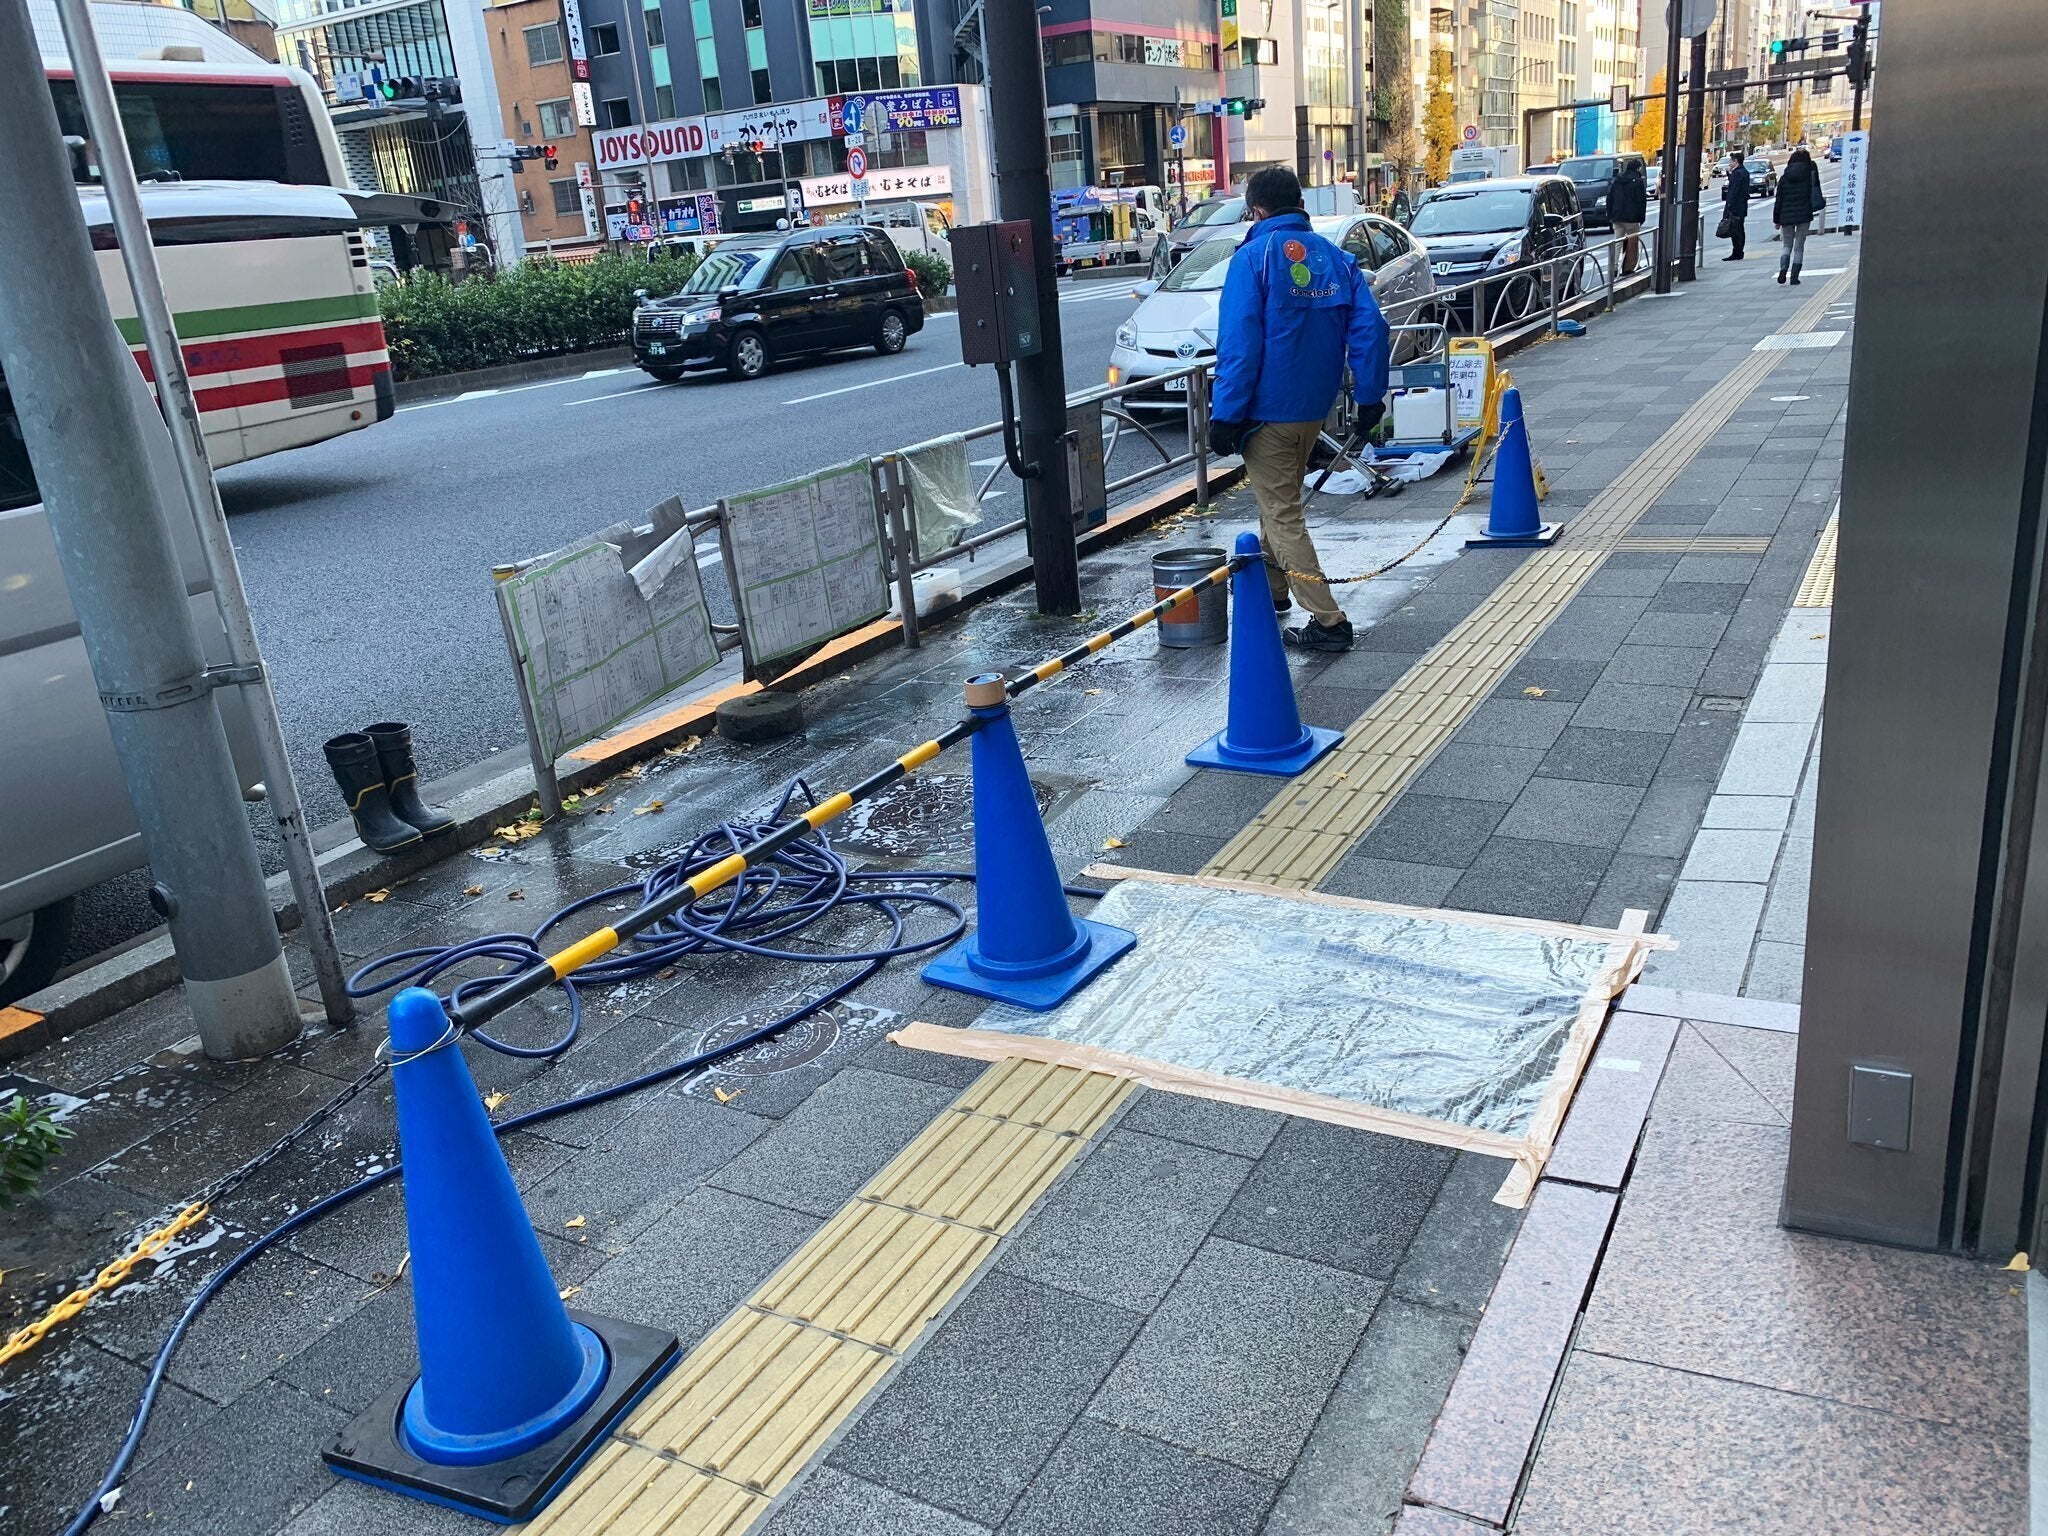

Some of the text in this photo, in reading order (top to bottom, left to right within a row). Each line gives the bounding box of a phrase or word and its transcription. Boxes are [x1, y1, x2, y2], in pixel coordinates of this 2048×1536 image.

[600, 125, 703, 163] JOYSOUND
[668, 206, 695, 220] カラオケ
[1449, 359, 1483, 369] ガム除去
[1450, 370, 1477, 380] 作業中
